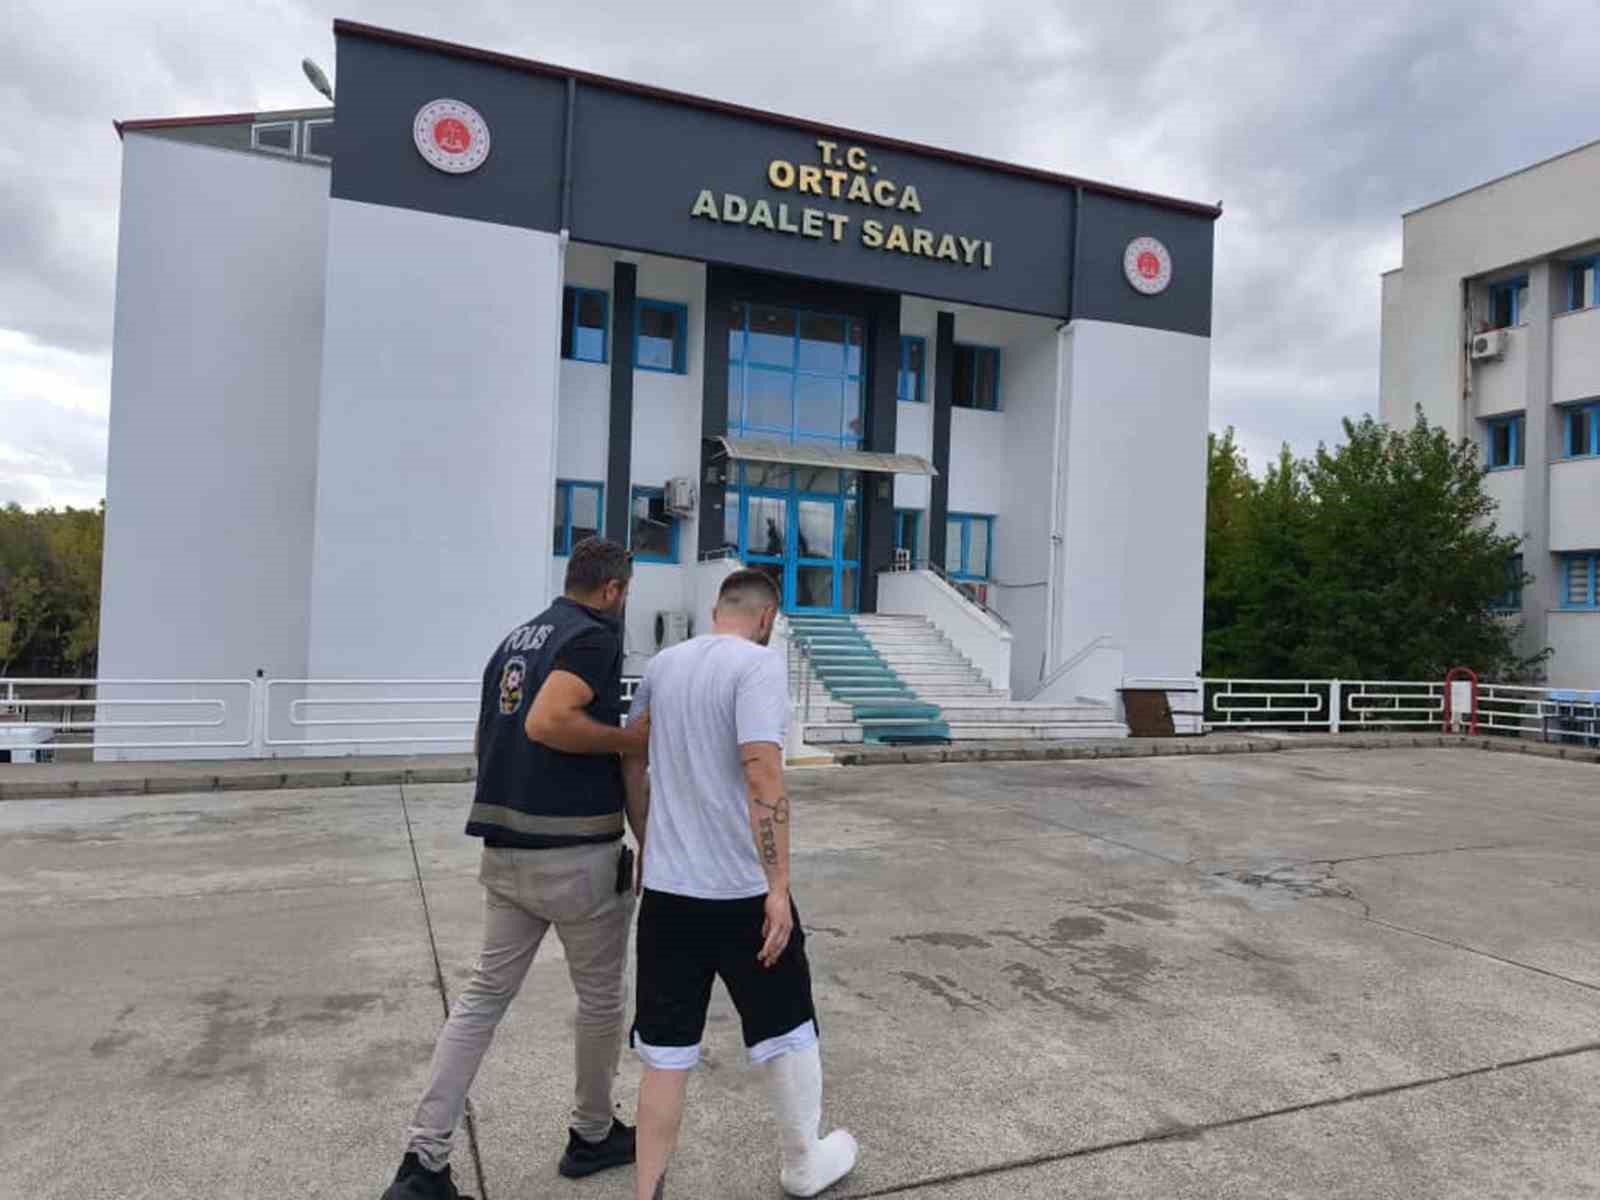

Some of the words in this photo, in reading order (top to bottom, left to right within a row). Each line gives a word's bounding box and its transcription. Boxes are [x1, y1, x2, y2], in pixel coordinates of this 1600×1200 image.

[817, 139, 877, 173] T.C.
[768, 159, 922, 213] ORTACA
[691, 190, 849, 241] ADALET
[862, 220, 993, 267] SARAYI
